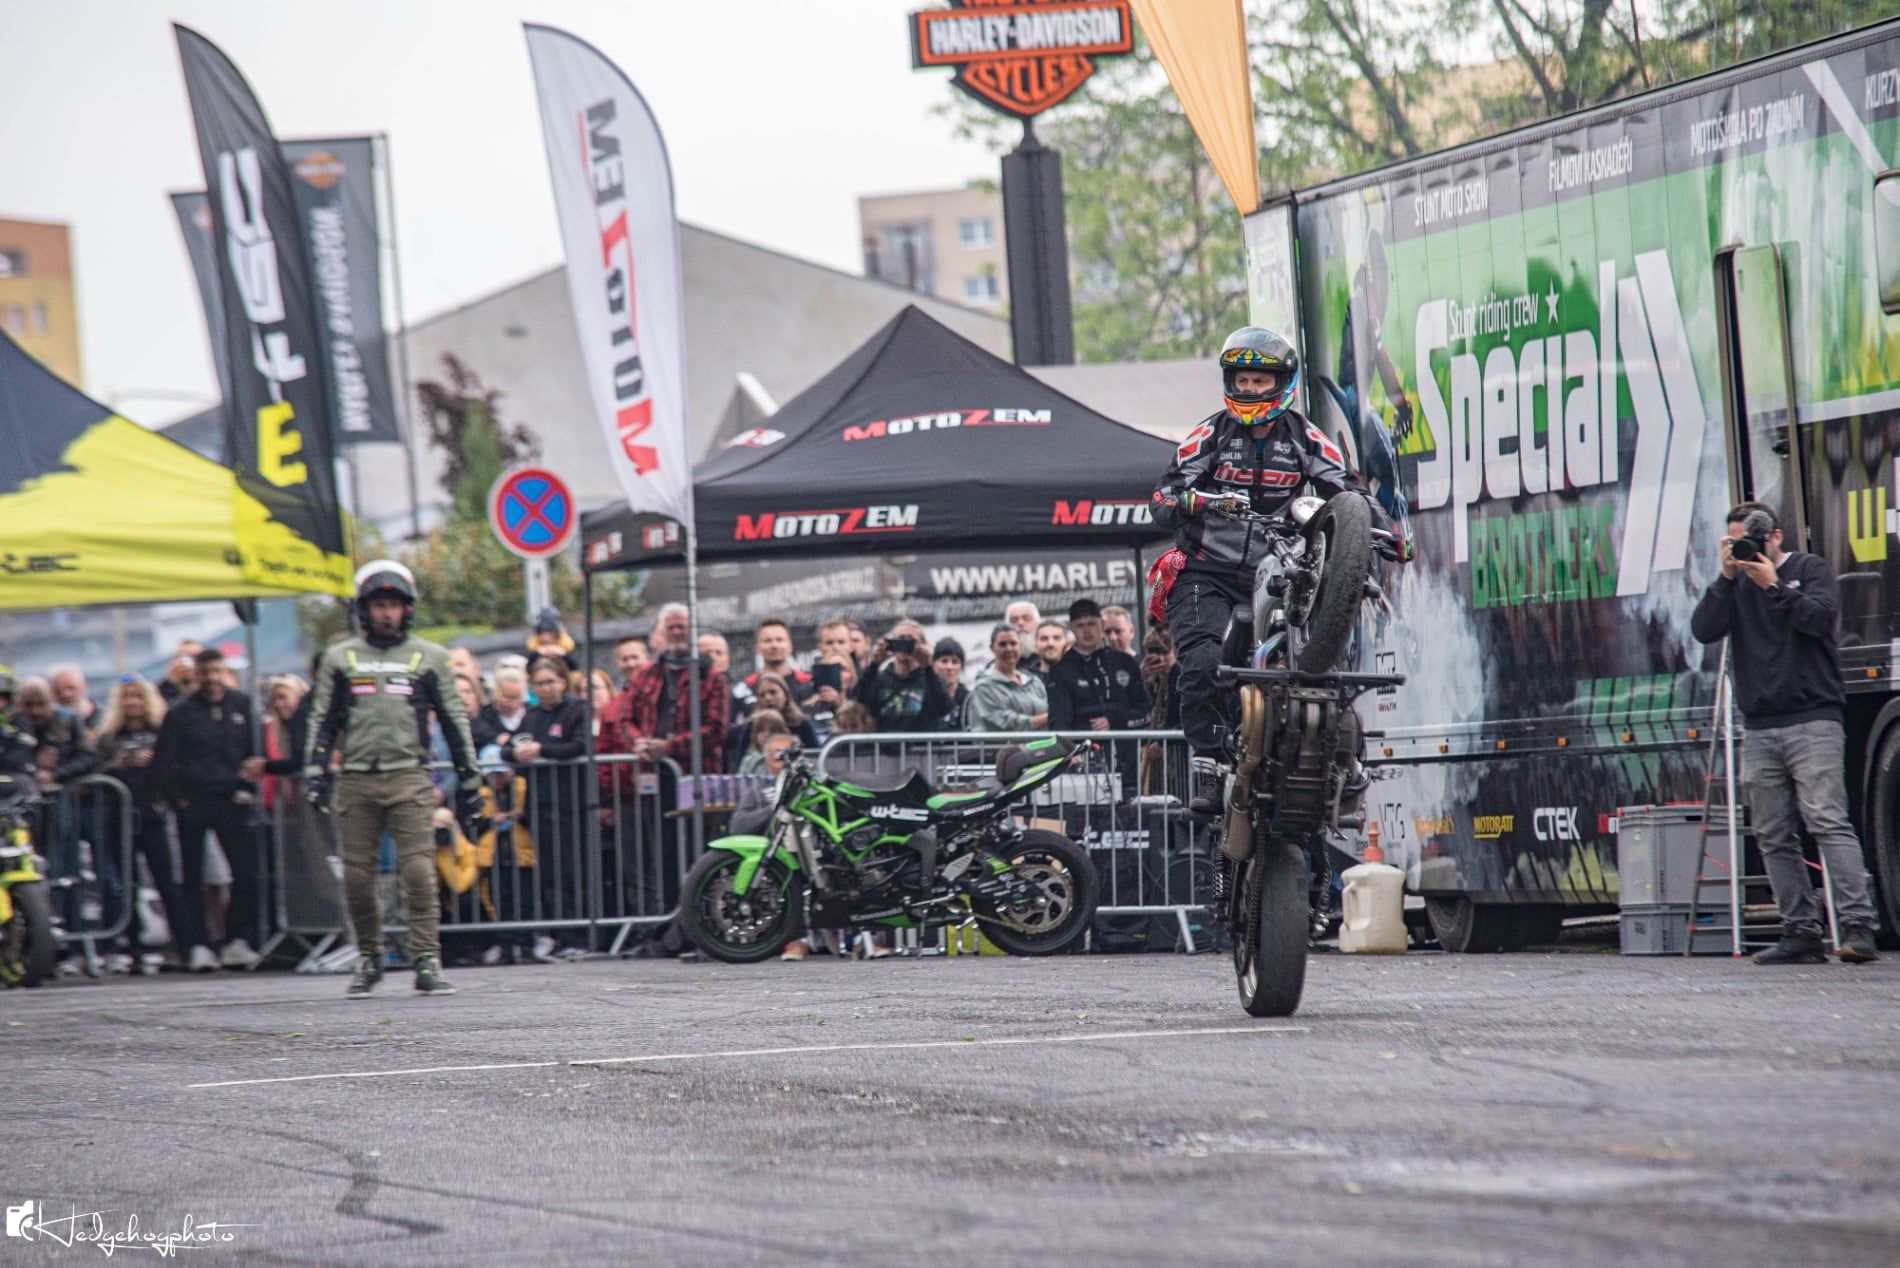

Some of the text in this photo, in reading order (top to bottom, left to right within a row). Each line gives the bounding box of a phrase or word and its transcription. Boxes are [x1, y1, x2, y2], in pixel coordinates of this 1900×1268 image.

[929, 8, 1121, 55] HARLEY-DAVIDSON
[977, 54, 1079, 102] CYCLES
[1749, 105, 1763, 141] PO
[1415, 178, 1489, 227] STUNT MOTO SHOW
[1449, 291, 1539, 342] Stunt riding crew
[1415, 258, 1619, 564] Special
[1471, 503, 1617, 609] BROTHERS
[1533, 807, 1581, 841] CTEK
